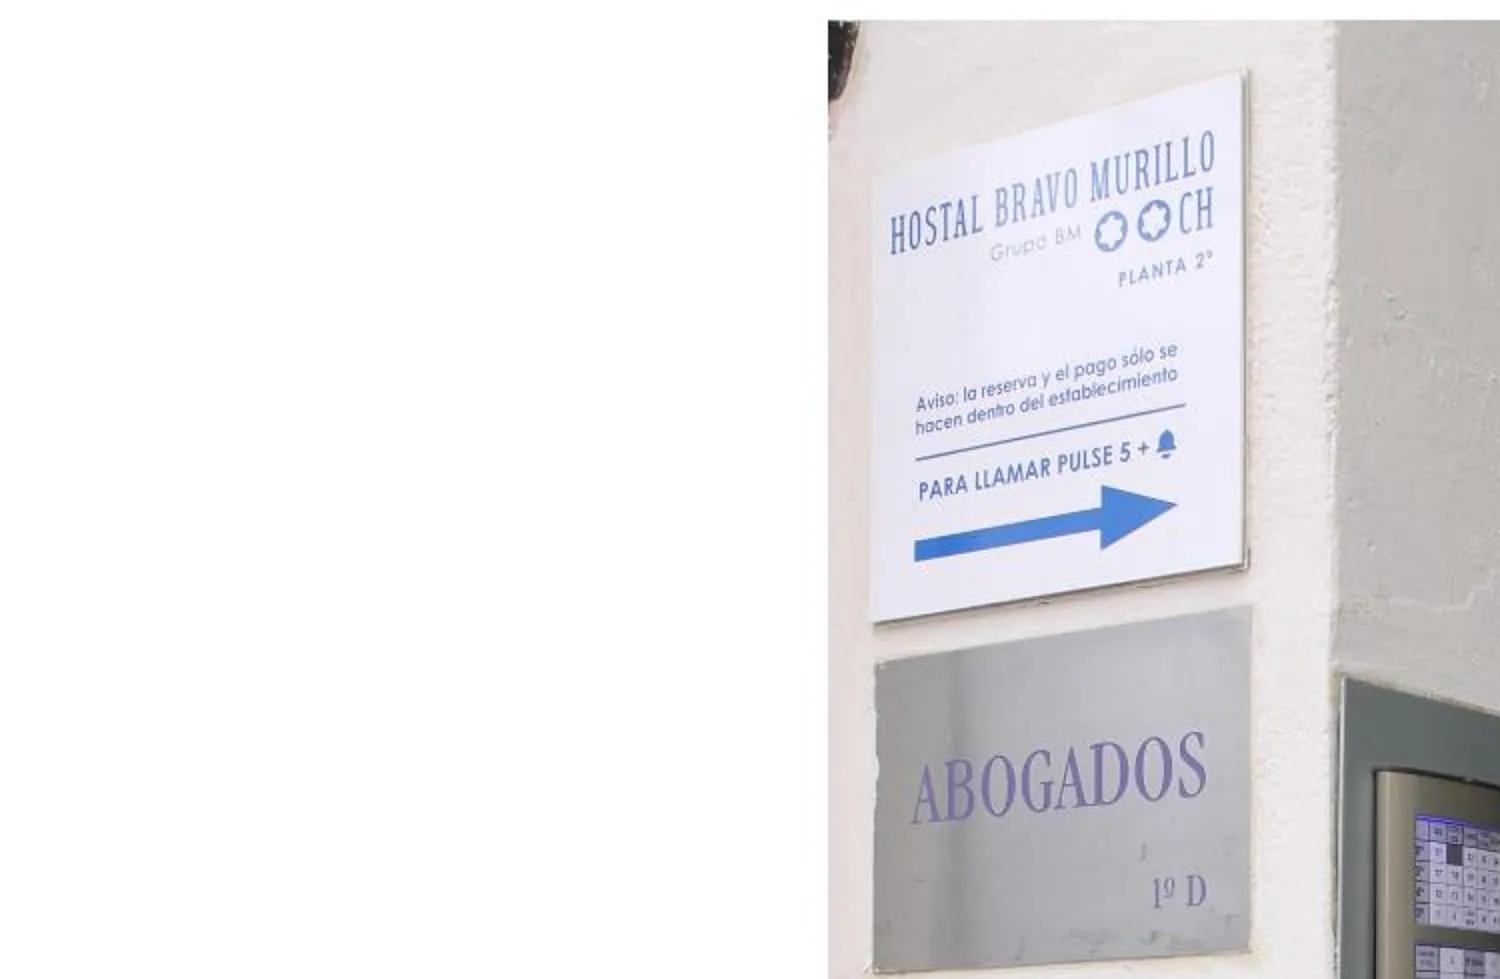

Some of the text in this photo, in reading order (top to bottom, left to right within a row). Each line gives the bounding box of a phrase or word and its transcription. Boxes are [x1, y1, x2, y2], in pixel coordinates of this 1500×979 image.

[890, 130, 1216, 256] HOSTAL BRAVO MURILLO
[1179, 186, 1214, 236] CH
[989, 223, 1083, 263] Grupo BM
[1118, 256, 1187, 288] PLANTA
[914, 366, 1179, 436] hacen dentro del establecimiento
[915, 342, 1179, 414] Aviso: la reserva y el pago sólo se
[918, 473, 969, 502] PARA
[974, 457, 1052, 492] LLAMAR
[1056, 445, 1114, 476] PULSE
[1119, 440, 1132, 464] 5
[910, 730, 1208, 825] ABOGADOS
[1186, 874, 1208, 908] D
